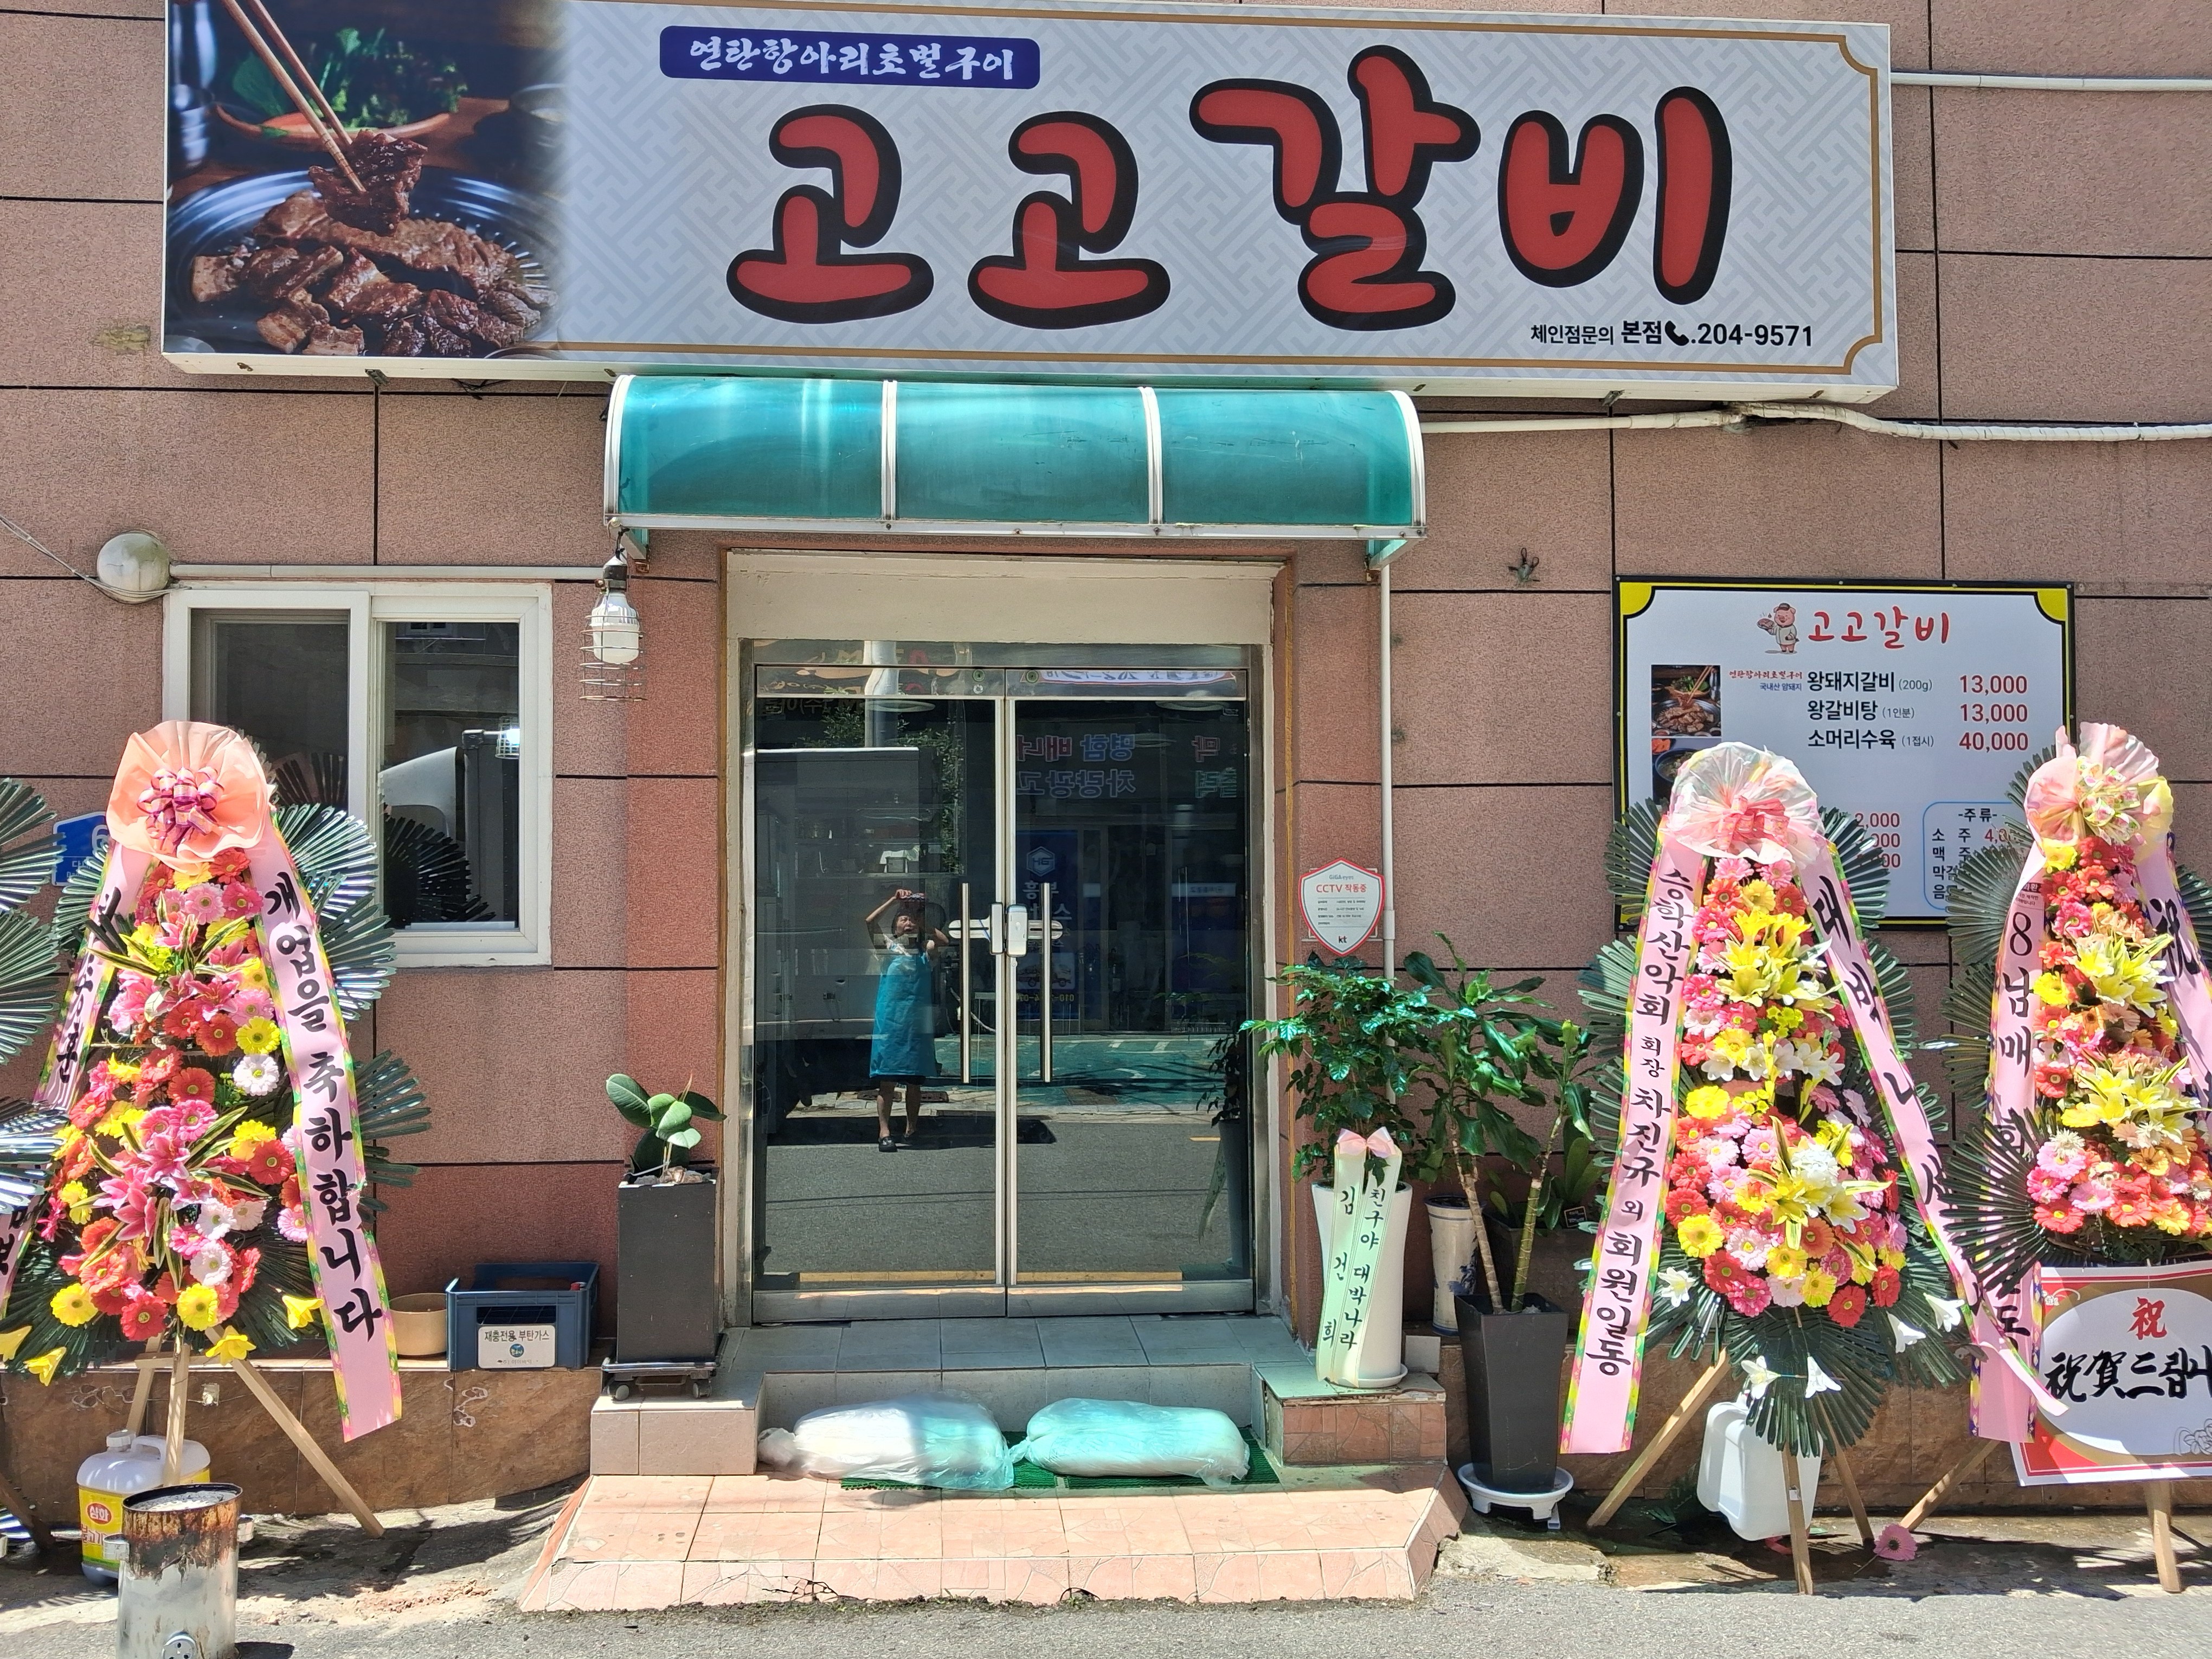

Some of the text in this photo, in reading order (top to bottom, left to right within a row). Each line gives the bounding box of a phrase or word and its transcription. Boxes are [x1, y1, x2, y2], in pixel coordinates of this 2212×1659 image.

[726, 44, 1733, 332] 고고갈비
[1531, 323, 1615, 346] 체인점문의
[1621, 320, 1663, 345] 본점
[1808, 606, 1950, 650] 고고갈비
[1759, 682, 1803, 692] 국내산 암돼지
[1807, 671, 2028, 696] 왕돼지갈비 (200g) 13,000
[1807, 700, 2029, 724] 왕갈비탕 (1인분) 13,000
[1808, 729, 2029, 753] 소머리수육 (1접시) 40,000
[1316, 883, 1367, 893] CCTV 작동중
[1338, 935, 1347, 943] kt
[1999, 911, 2035, 1079] 8남매
[265, 871, 383, 1342] 개업을 축하합니다
[1585, 868, 1694, 1377] 승학산악회 회장 차진규 외 회원일동
[1339, 1187, 1387, 1351] 친구야 대박나라
[2127, 1296, 2168, 1341] 祝
[484, 1329, 550, 1342] 재충전용 부탄가스
[89, 1506, 110, 1522] 삼화
